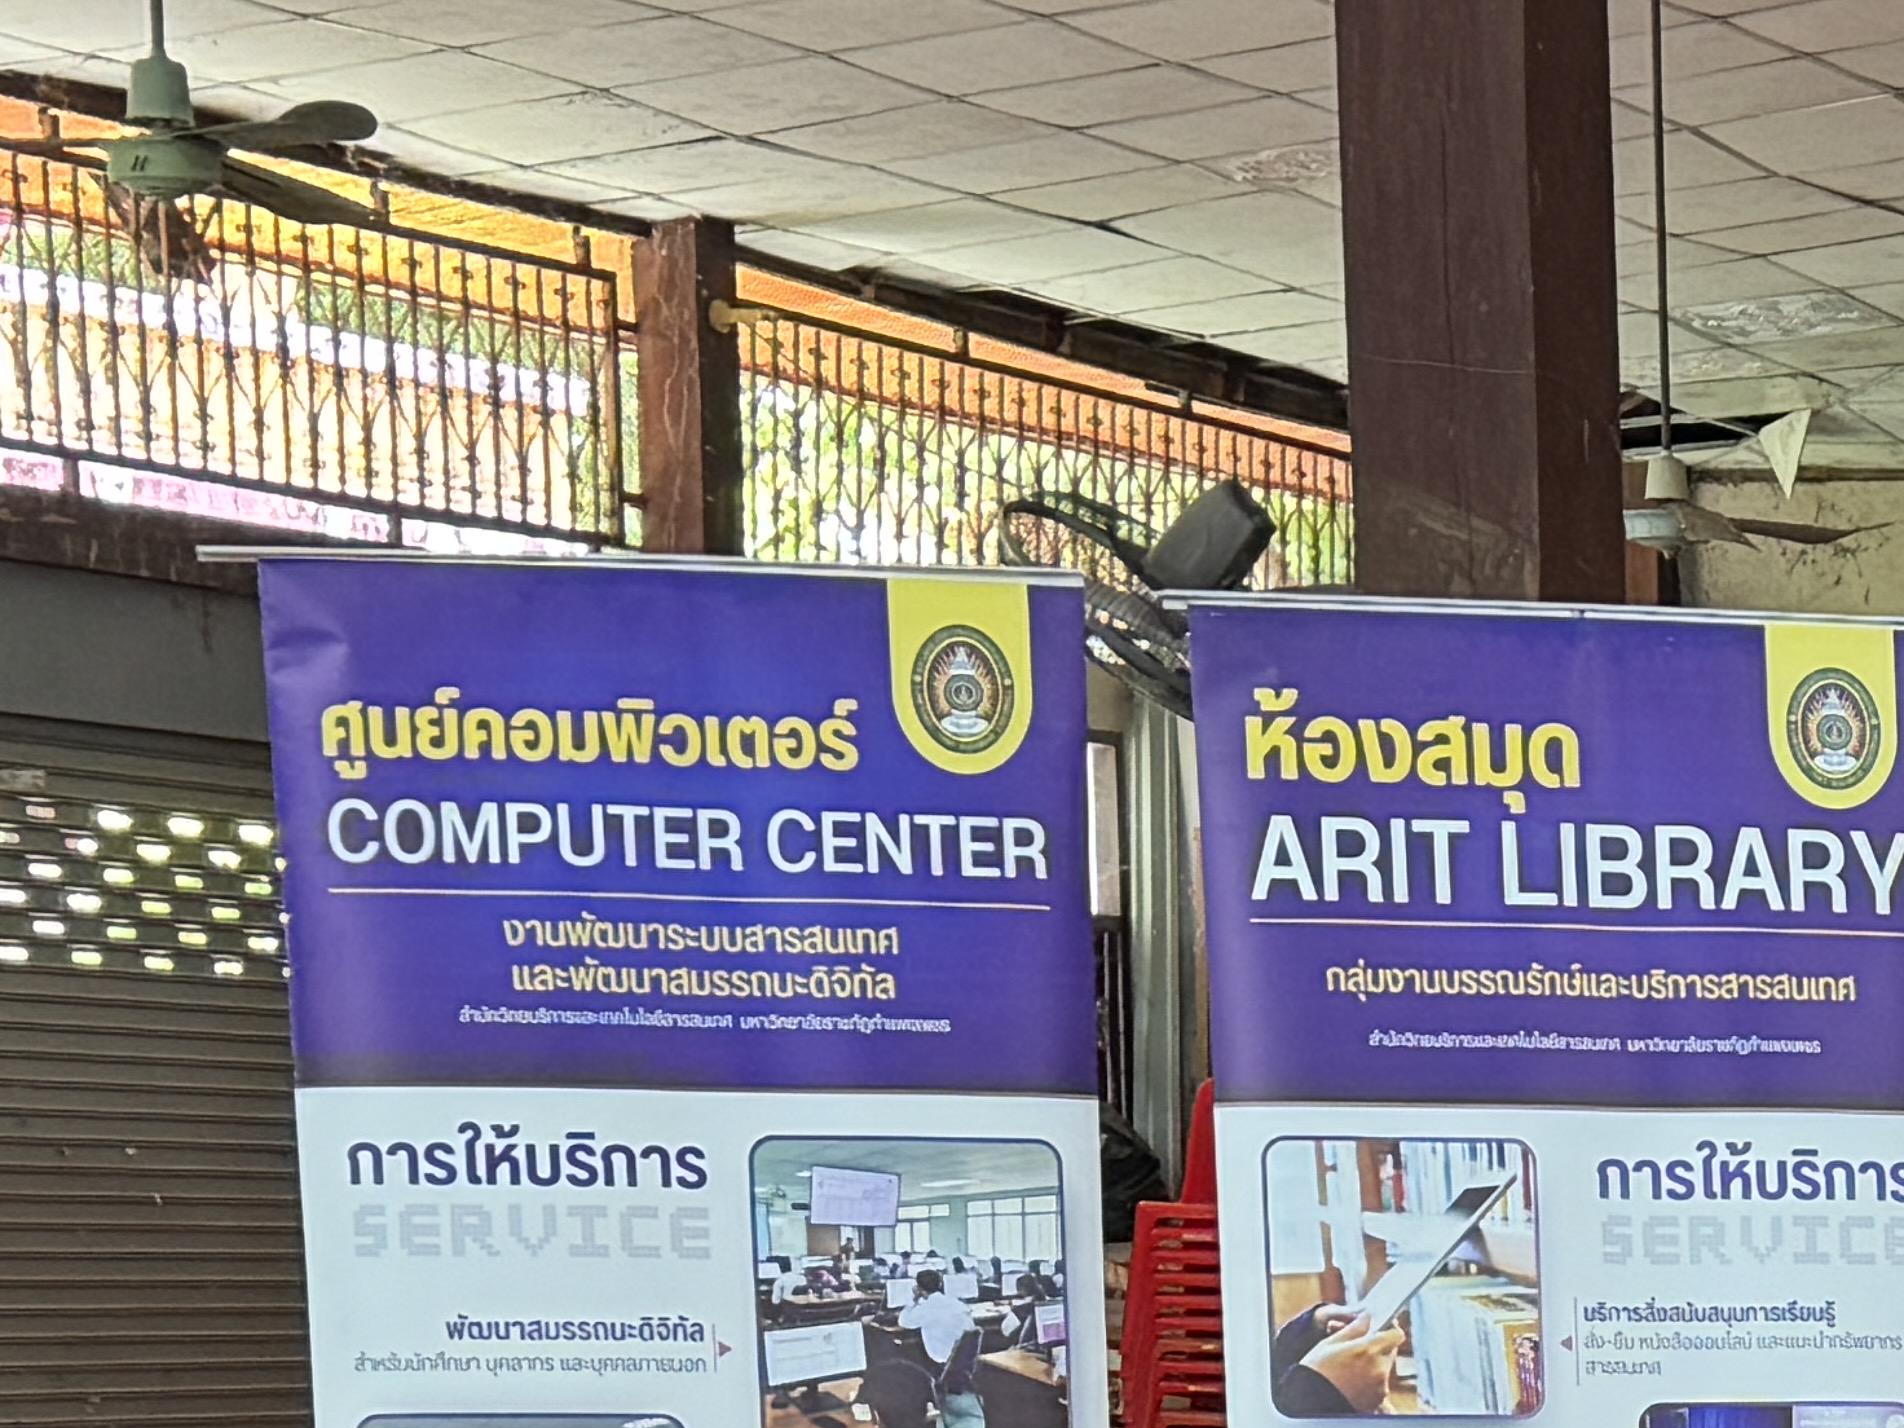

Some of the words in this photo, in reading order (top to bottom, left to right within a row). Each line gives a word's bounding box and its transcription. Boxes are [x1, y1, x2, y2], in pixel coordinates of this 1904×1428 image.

[321, 686, 859, 780] ศูนย์คอมพิวเตอร์
[1244, 687, 1581, 814] ห้องสมุด
[328, 797, 744, 872] COMPUTER
[768, 808, 1048, 880] CENTER
[1250, 815, 1471, 904] ARIT
[503, 912, 899, 955] งานพัฒนาระบบสารสนเทศ
[512, 956, 896, 999] และพัฒนาสมรรถนะดิจิทัล
[1326, 958, 1856, 1002] กลุ่มงานบรรณรักษ์และบริการสารสนเทศ
[347, 1121, 708, 1190] การให้บริการ
[353, 1203, 711, 1260] SERVICE
[446, 1314, 706, 1343] พัฒนาสมรรถนะดิจิทัล
[1583, 1296, 1836, 1328] บริการสิ่งสนับสนุนการเรียนรู้
